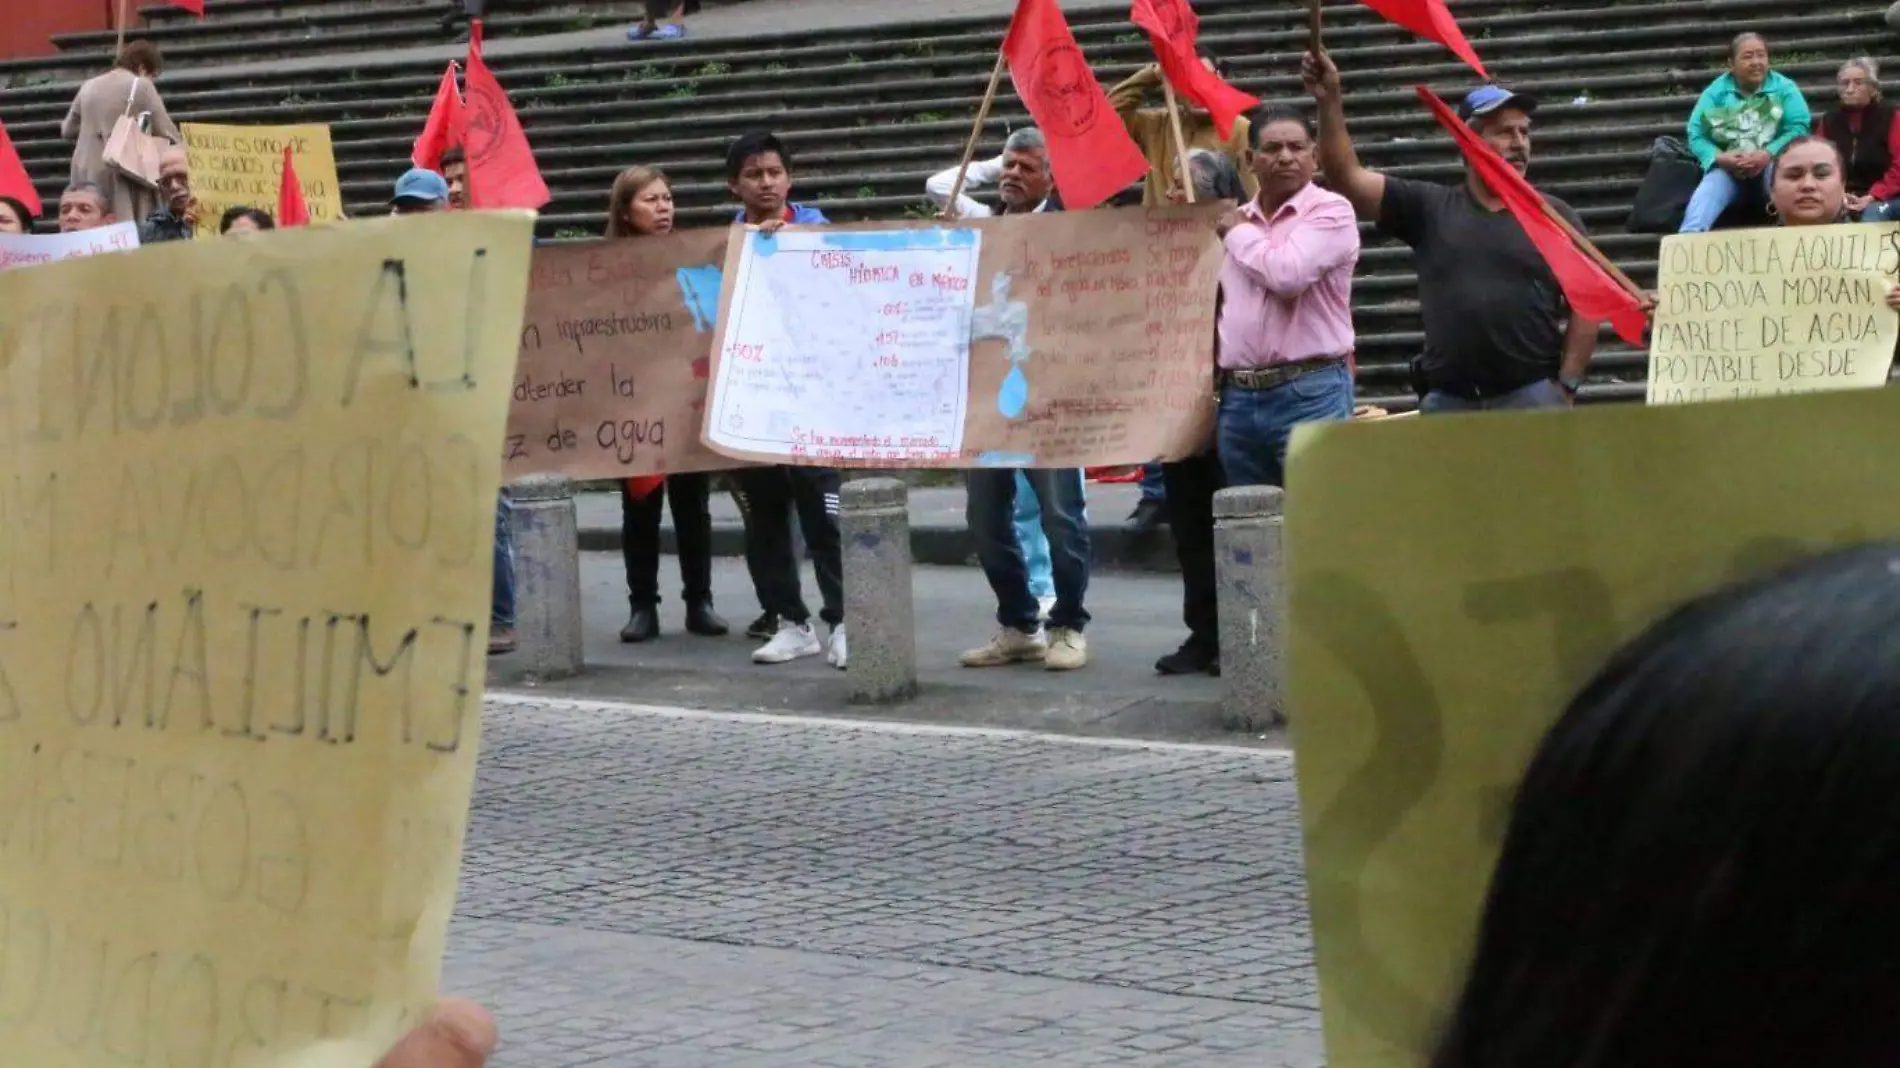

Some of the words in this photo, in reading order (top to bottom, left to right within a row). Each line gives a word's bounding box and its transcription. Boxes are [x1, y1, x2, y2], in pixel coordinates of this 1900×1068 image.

[1791, 230, 1900, 275] AQUILES
[1657, 318, 1746, 354] CARECE
[1761, 314, 1794, 348] DE
[1807, 312, 1880, 345] AGUA
[513, 368, 586, 402] atender
[610, 362, 635, 398] la
[1654, 353, 1765, 384] POTABLE
[1778, 348, 1858, 380] DESDE
[547, 418, 577, 452] de
[596, 417, 665, 465] agua
